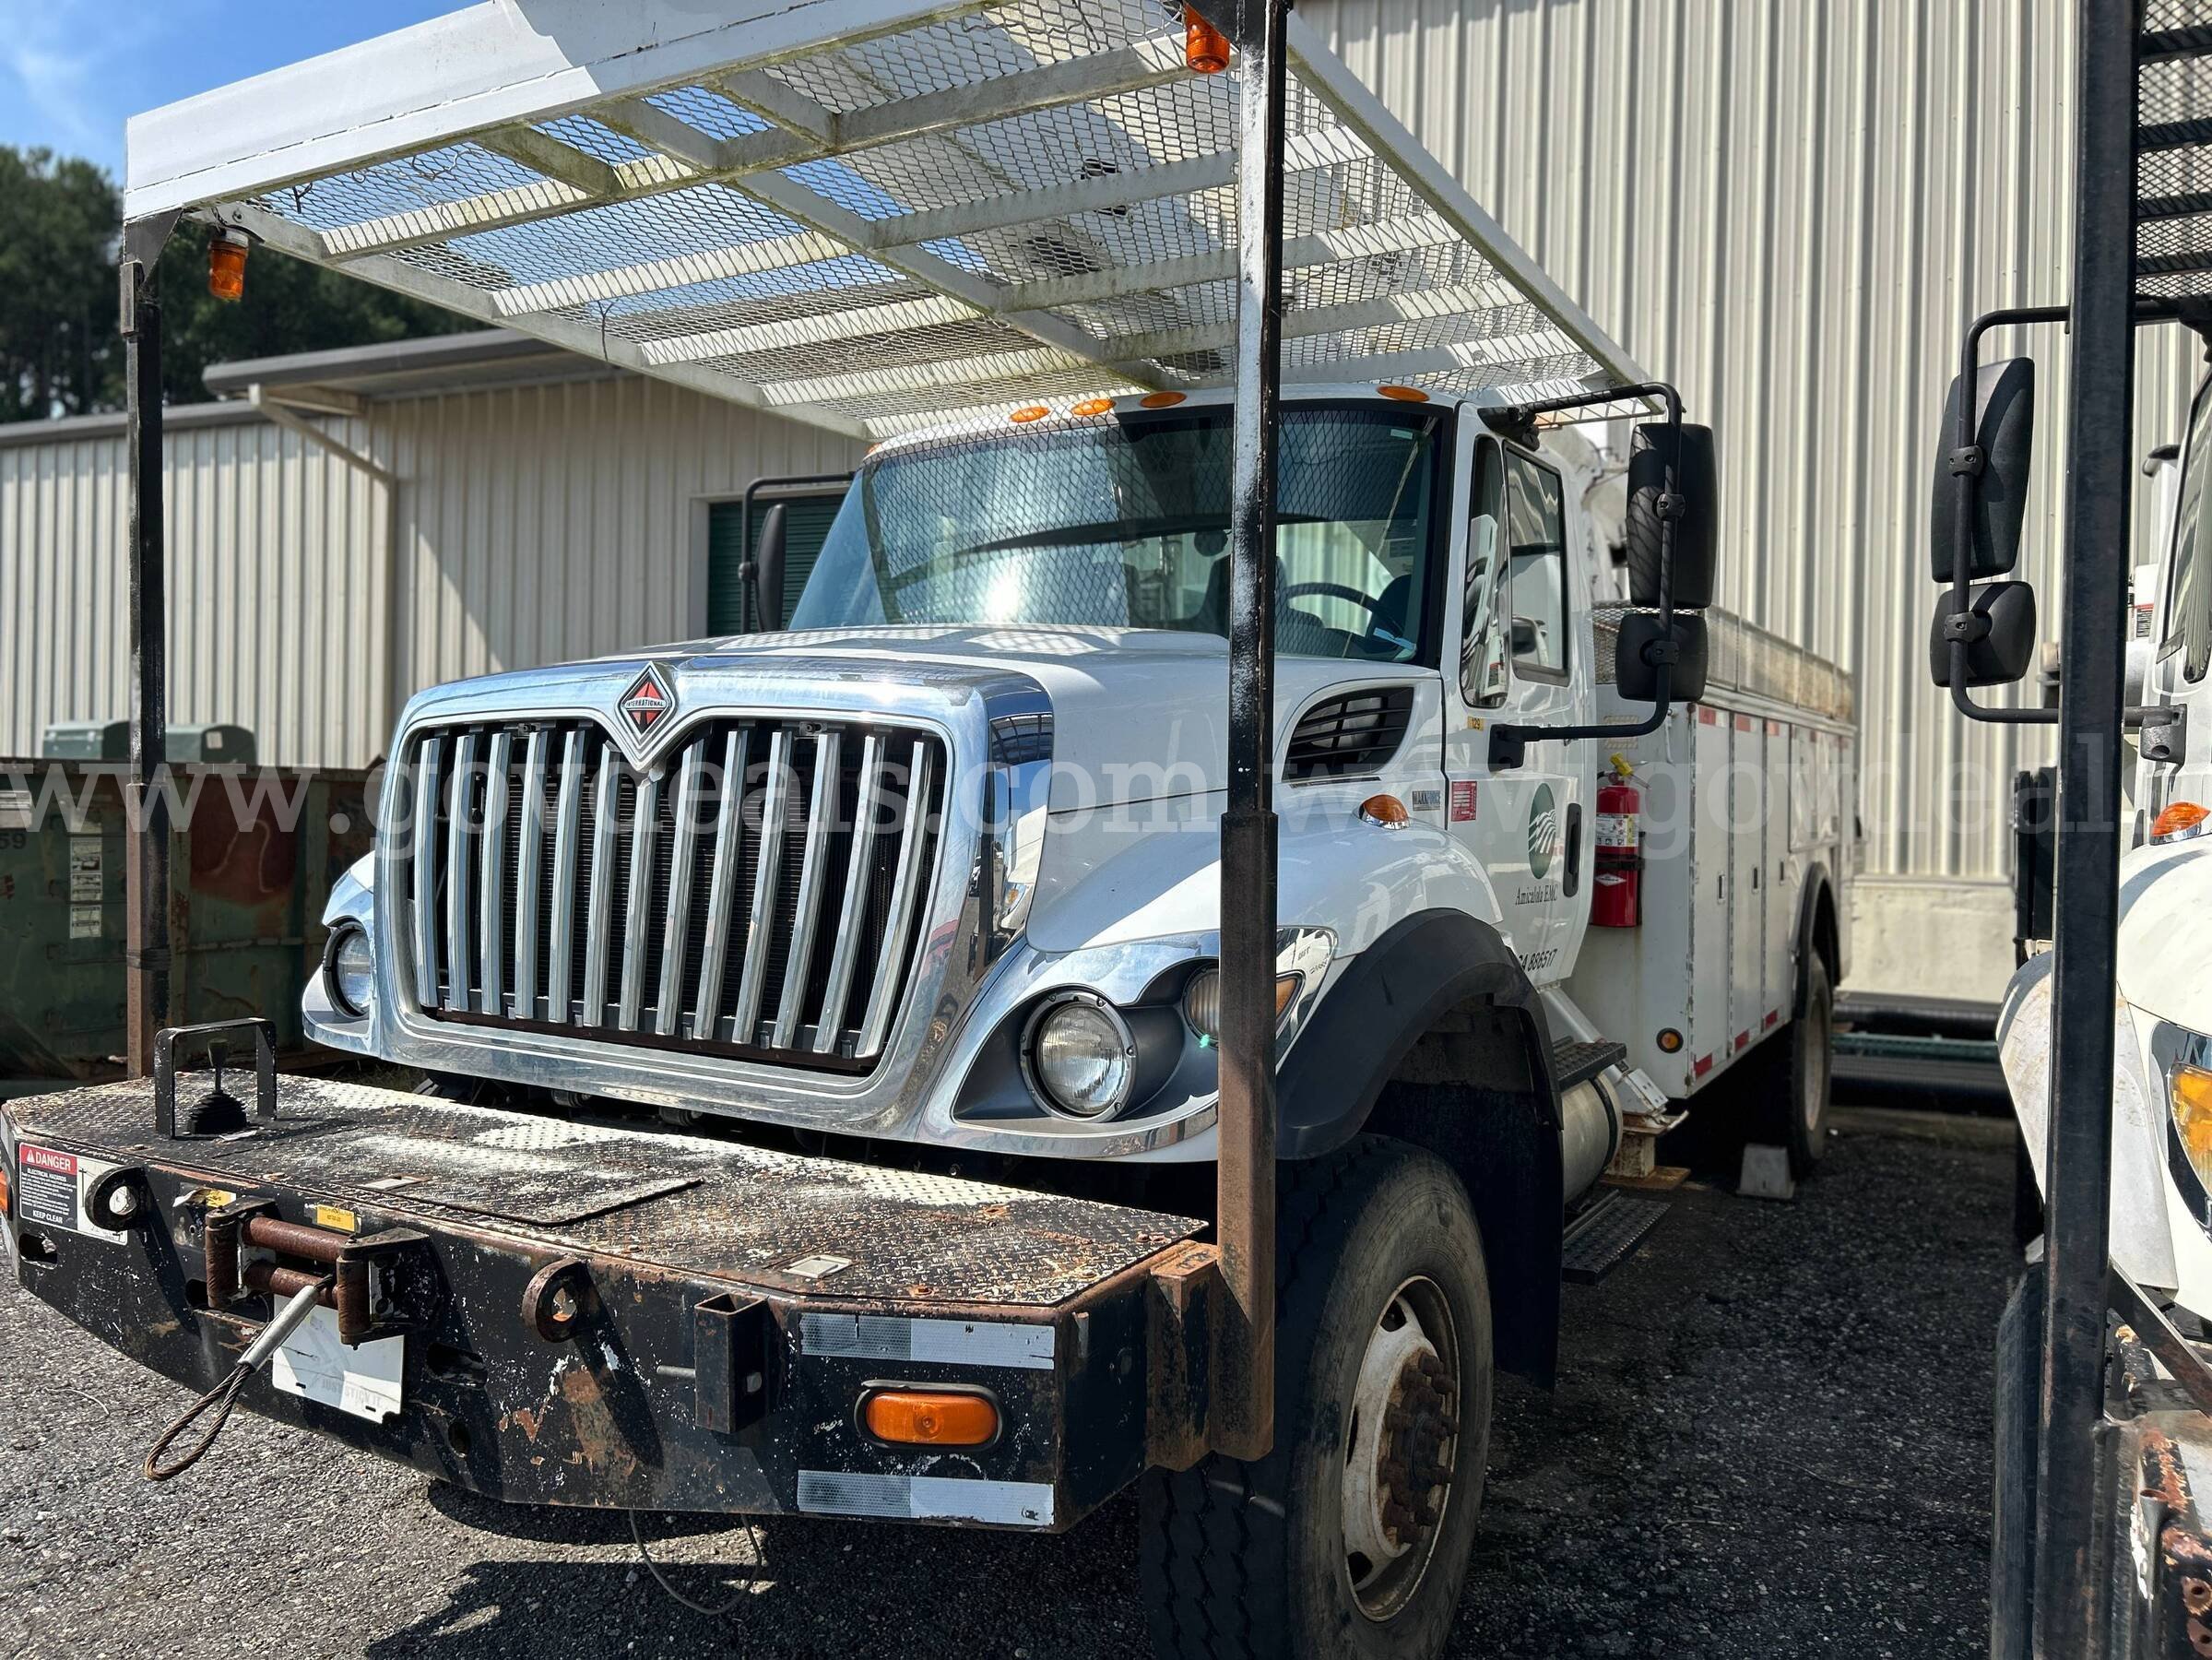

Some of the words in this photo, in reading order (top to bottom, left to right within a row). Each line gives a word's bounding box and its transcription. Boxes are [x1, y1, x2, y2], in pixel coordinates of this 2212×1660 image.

[627, 699, 664, 708] INTERNATIONAL
[1544, 884, 1558, 902] EMC
[35, 1151, 71, 1171] DANGER
[32, 1210, 46, 1219] KEEP
[46, 1214, 64, 1224] CLEAR
